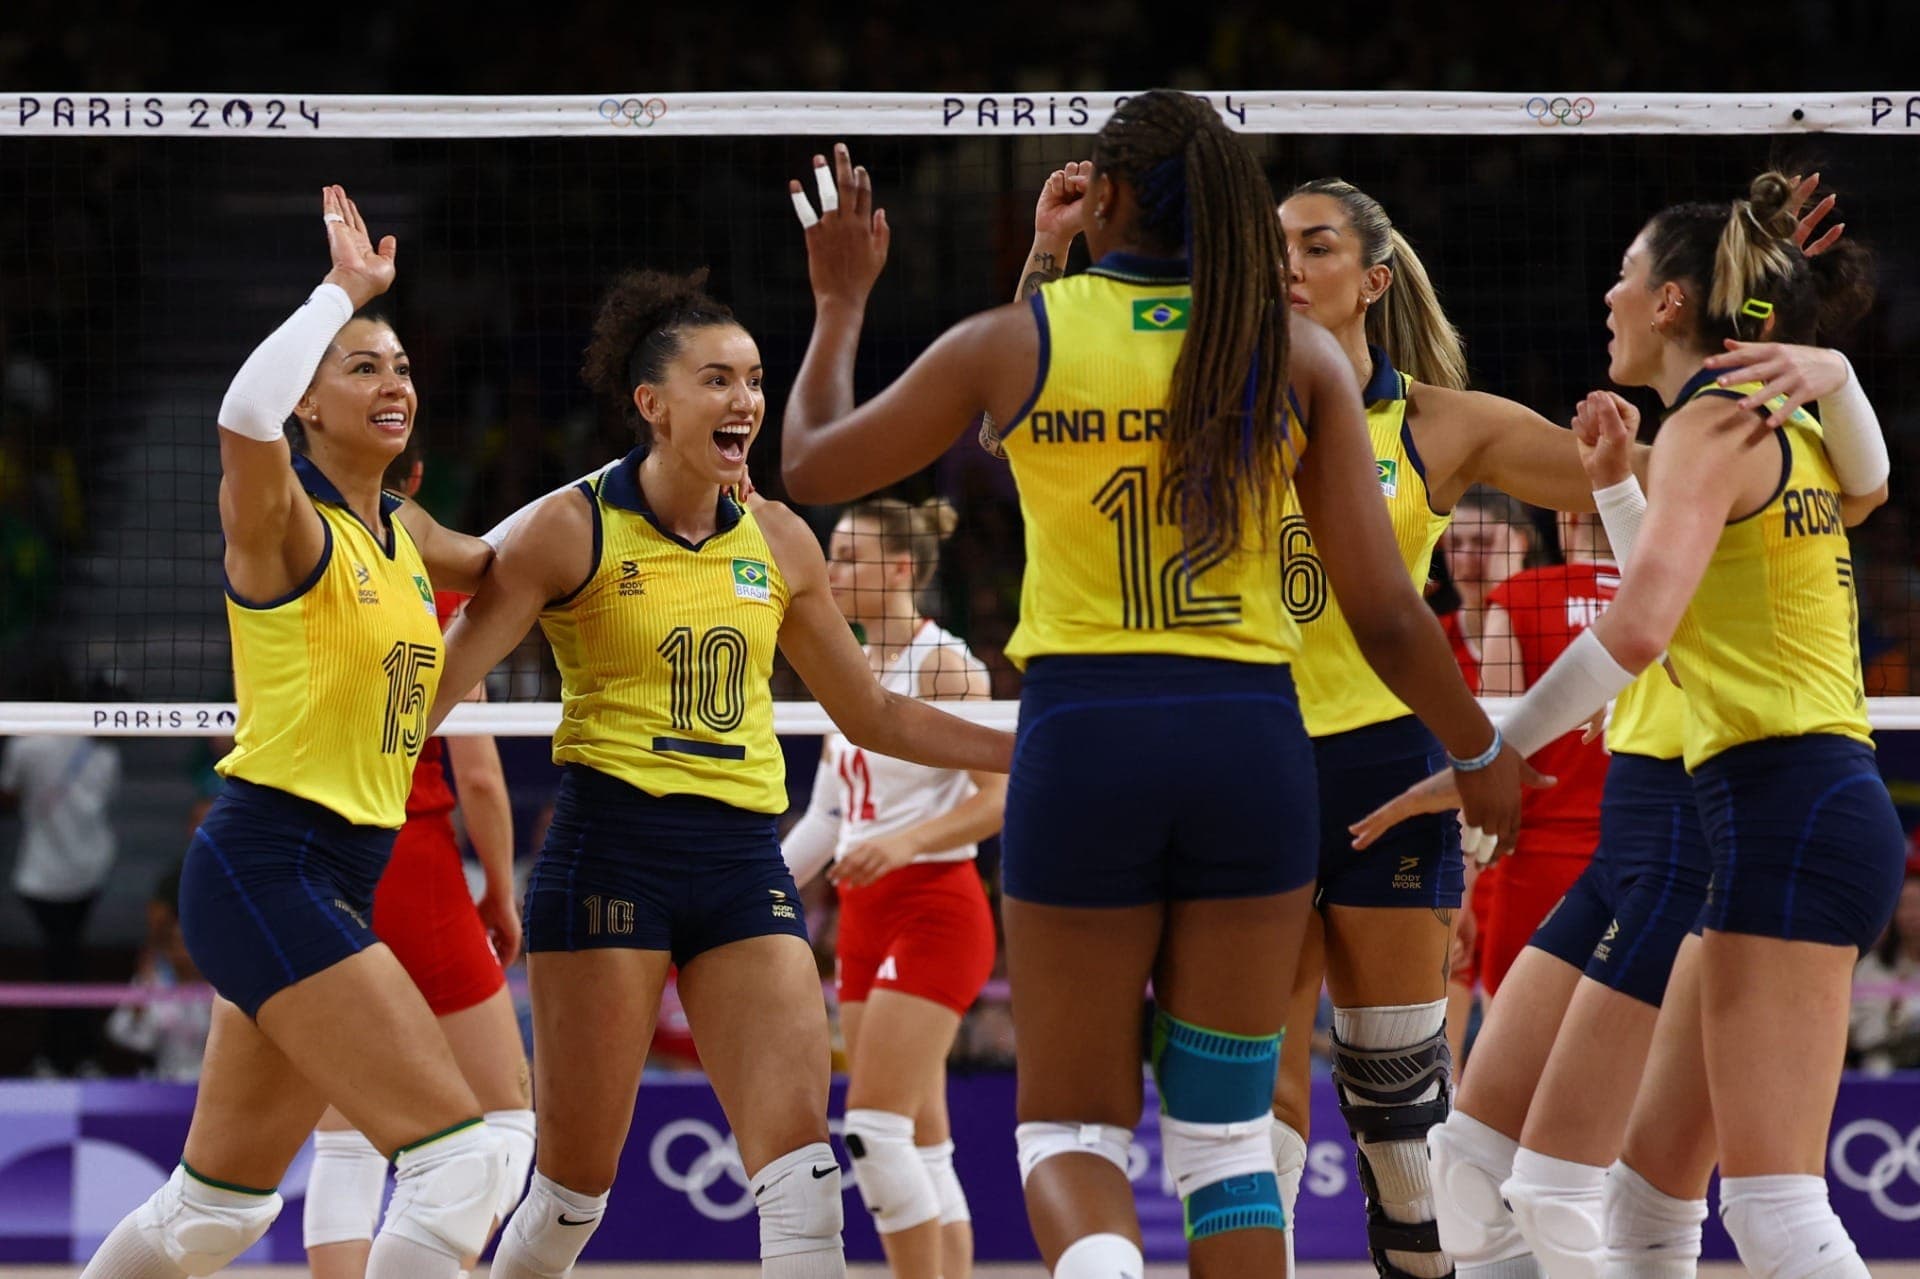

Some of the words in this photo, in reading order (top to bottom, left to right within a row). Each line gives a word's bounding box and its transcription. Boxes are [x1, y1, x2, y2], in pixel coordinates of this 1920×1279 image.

[1030, 409, 1106, 443] ANA
[1117, 408, 1169, 442] CR
[1090, 465, 1243, 630] 12
[1279, 513, 1328, 624] 6
[618, 589, 647, 597] WORK
[620, 581, 644, 589] BODY
[736, 584, 769, 601] BRASIL
[656, 625, 748, 734] 10
[381, 640, 436, 758] 15
[196, 710, 236, 728] 20
[1391, 881, 1423, 889] WORK
[1393, 873, 1421, 882] BODY
[582, 894, 634, 936] 10
